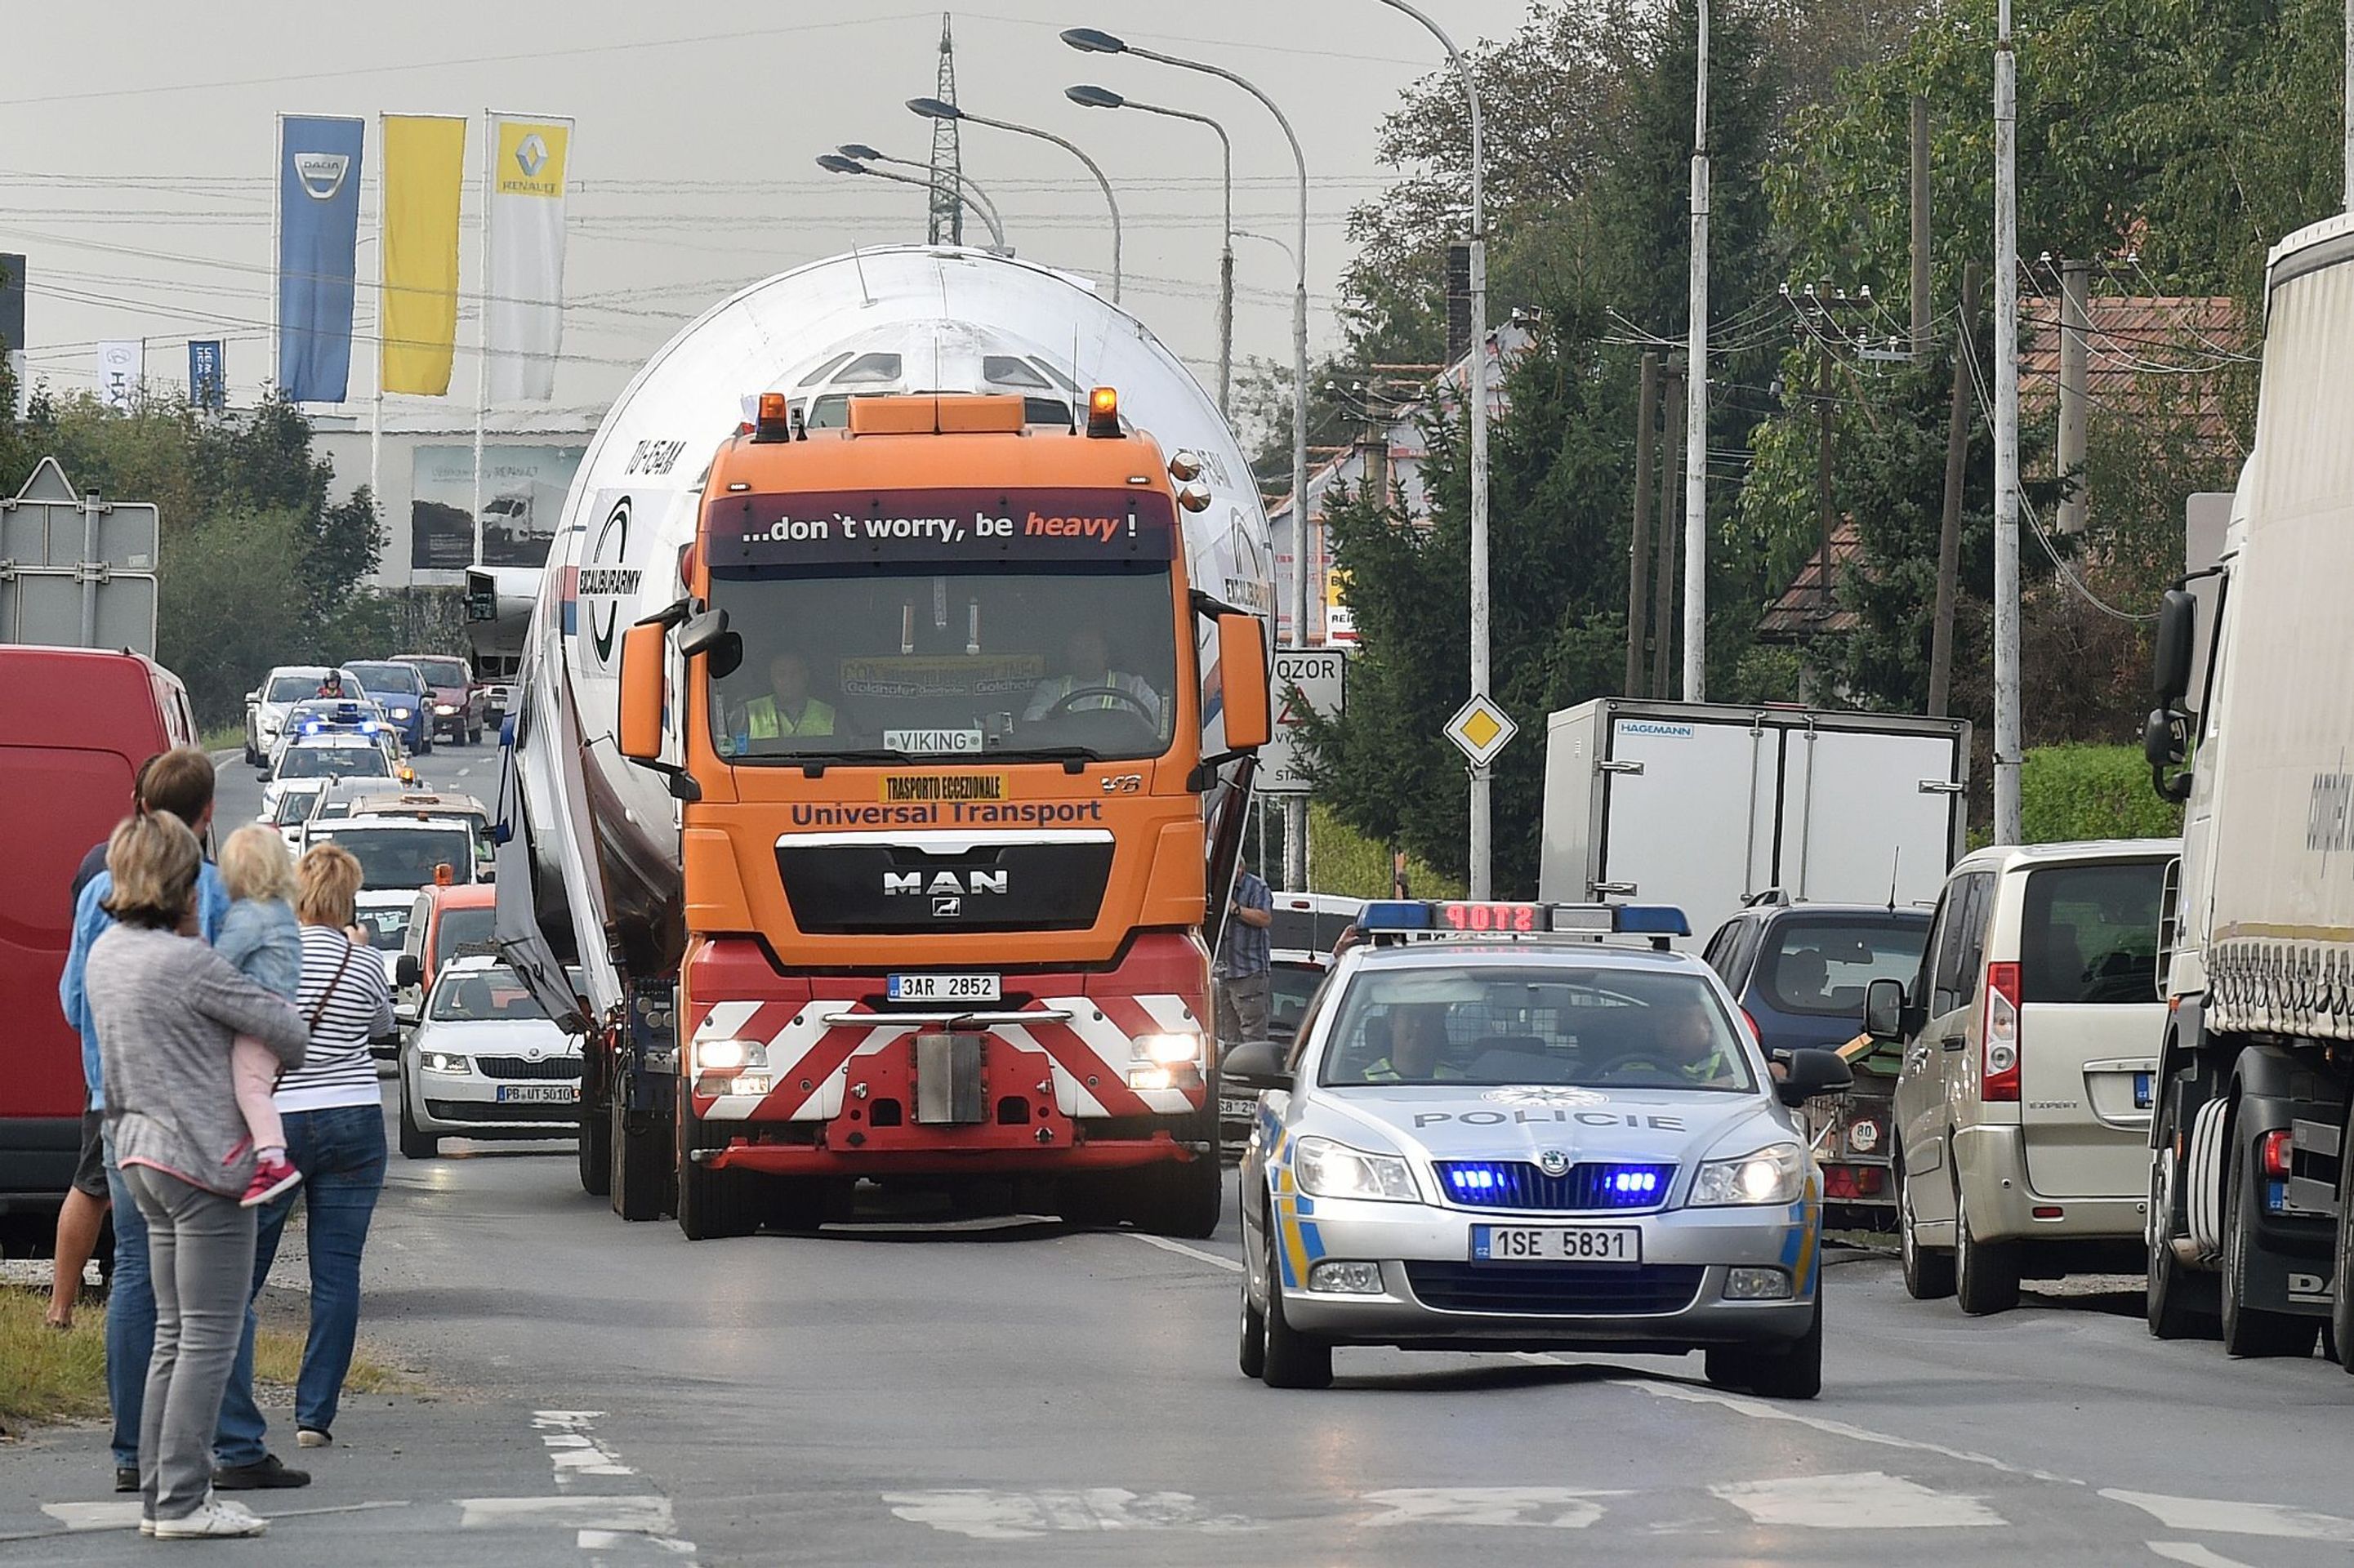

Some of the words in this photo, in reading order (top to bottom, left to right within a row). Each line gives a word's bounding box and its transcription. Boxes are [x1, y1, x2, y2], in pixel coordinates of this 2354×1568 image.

[303, 161, 339, 170] DACIA
[502, 180, 556, 194] RENAULT
[864, 518, 965, 542] worry,
[975, 512, 1014, 537] be
[1024, 512, 1119, 542] heavy
[1127, 513, 1136, 537] !
[1277, 660, 1335, 679] OZOR
[1621, 724, 1691, 736] HAGEMANN
[899, 732, 967, 750] VIKING
[886, 777, 940, 800] TRASPORTO
[942, 775, 1001, 800] ECCEZIONALE
[792, 802, 938, 826] Universal
[947, 800, 1102, 826] Transport
[883, 870, 1008, 895] MAN
[903, 978, 934, 996] 3AR
[949, 978, 992, 996] 2852
[506, 1088, 519, 1100] PB
[2029, 1100, 2078, 1109] EXPERT
[1413, 1108, 1687, 1132] POLICIE
[1857, 1125, 1872, 1138] 80
[1497, 1231, 1543, 1256] 1SE
[1563, 1232, 1625, 1257] 5831
